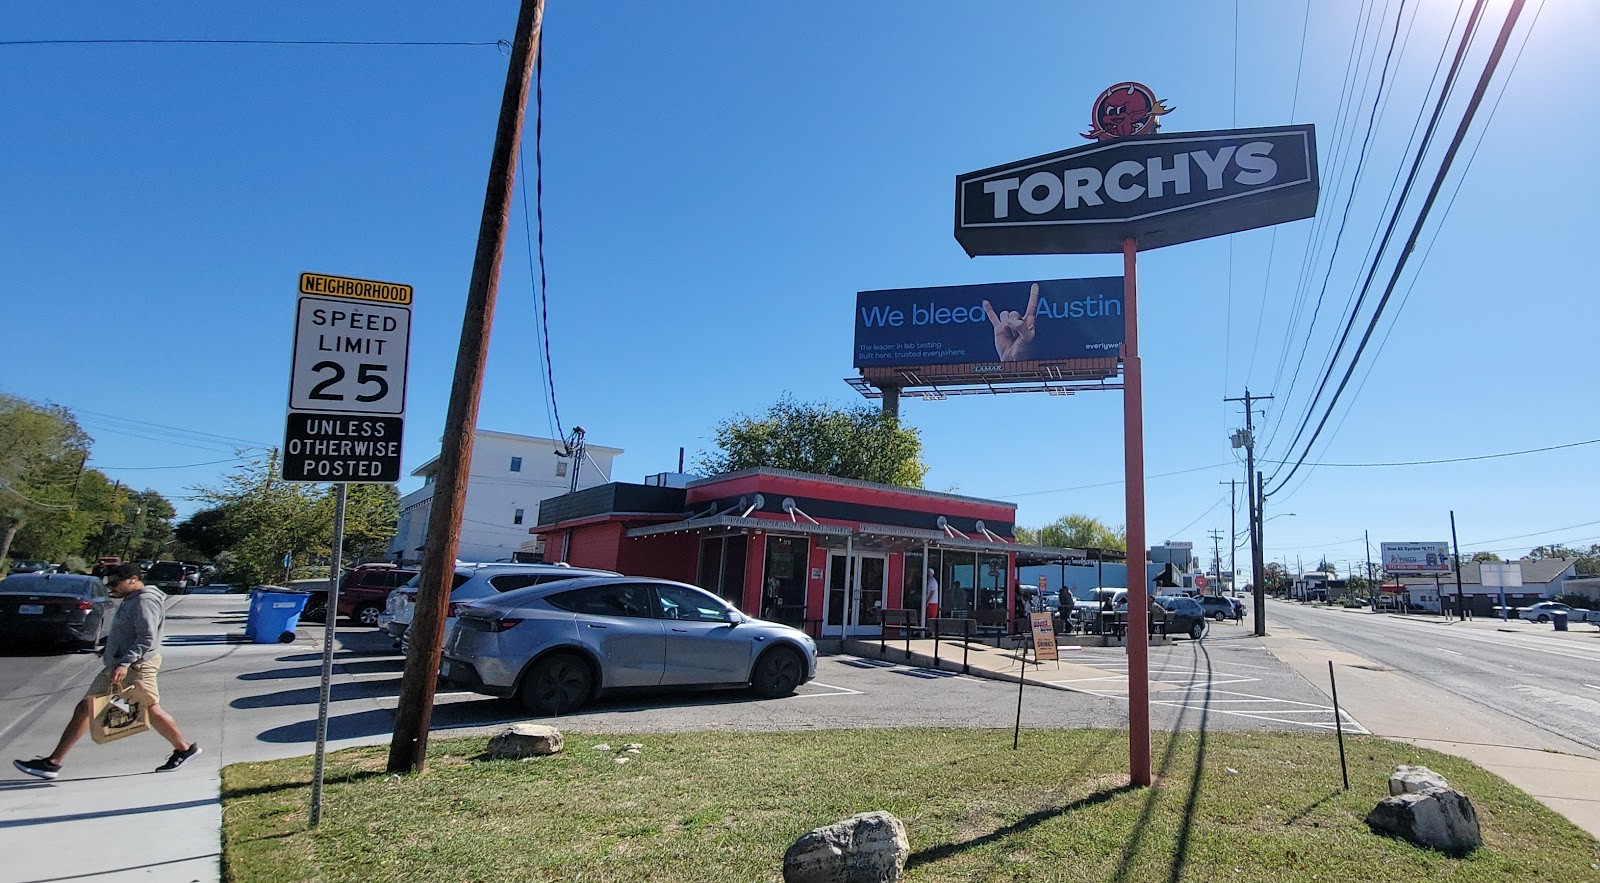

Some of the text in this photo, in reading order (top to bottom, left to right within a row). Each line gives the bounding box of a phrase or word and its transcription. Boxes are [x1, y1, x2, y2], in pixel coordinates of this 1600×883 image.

[983, 141, 1278, 219] TORCHYS
[305, 276, 407, 301] NEIGHBORHOOD
[312, 309, 397, 332] SPEED
[861, 294, 1121, 328] We bleed Austin
[318, 334, 387, 355] LIMIT
[858, 352, 874, 360] Built
[894, 350, 921, 358] trusted
[308, 360, 389, 403] 25
[306, 419, 386, 437] UNLESS
[288, 439, 398, 457] OTHERWISE
[303, 460, 382, 476] POSTED
